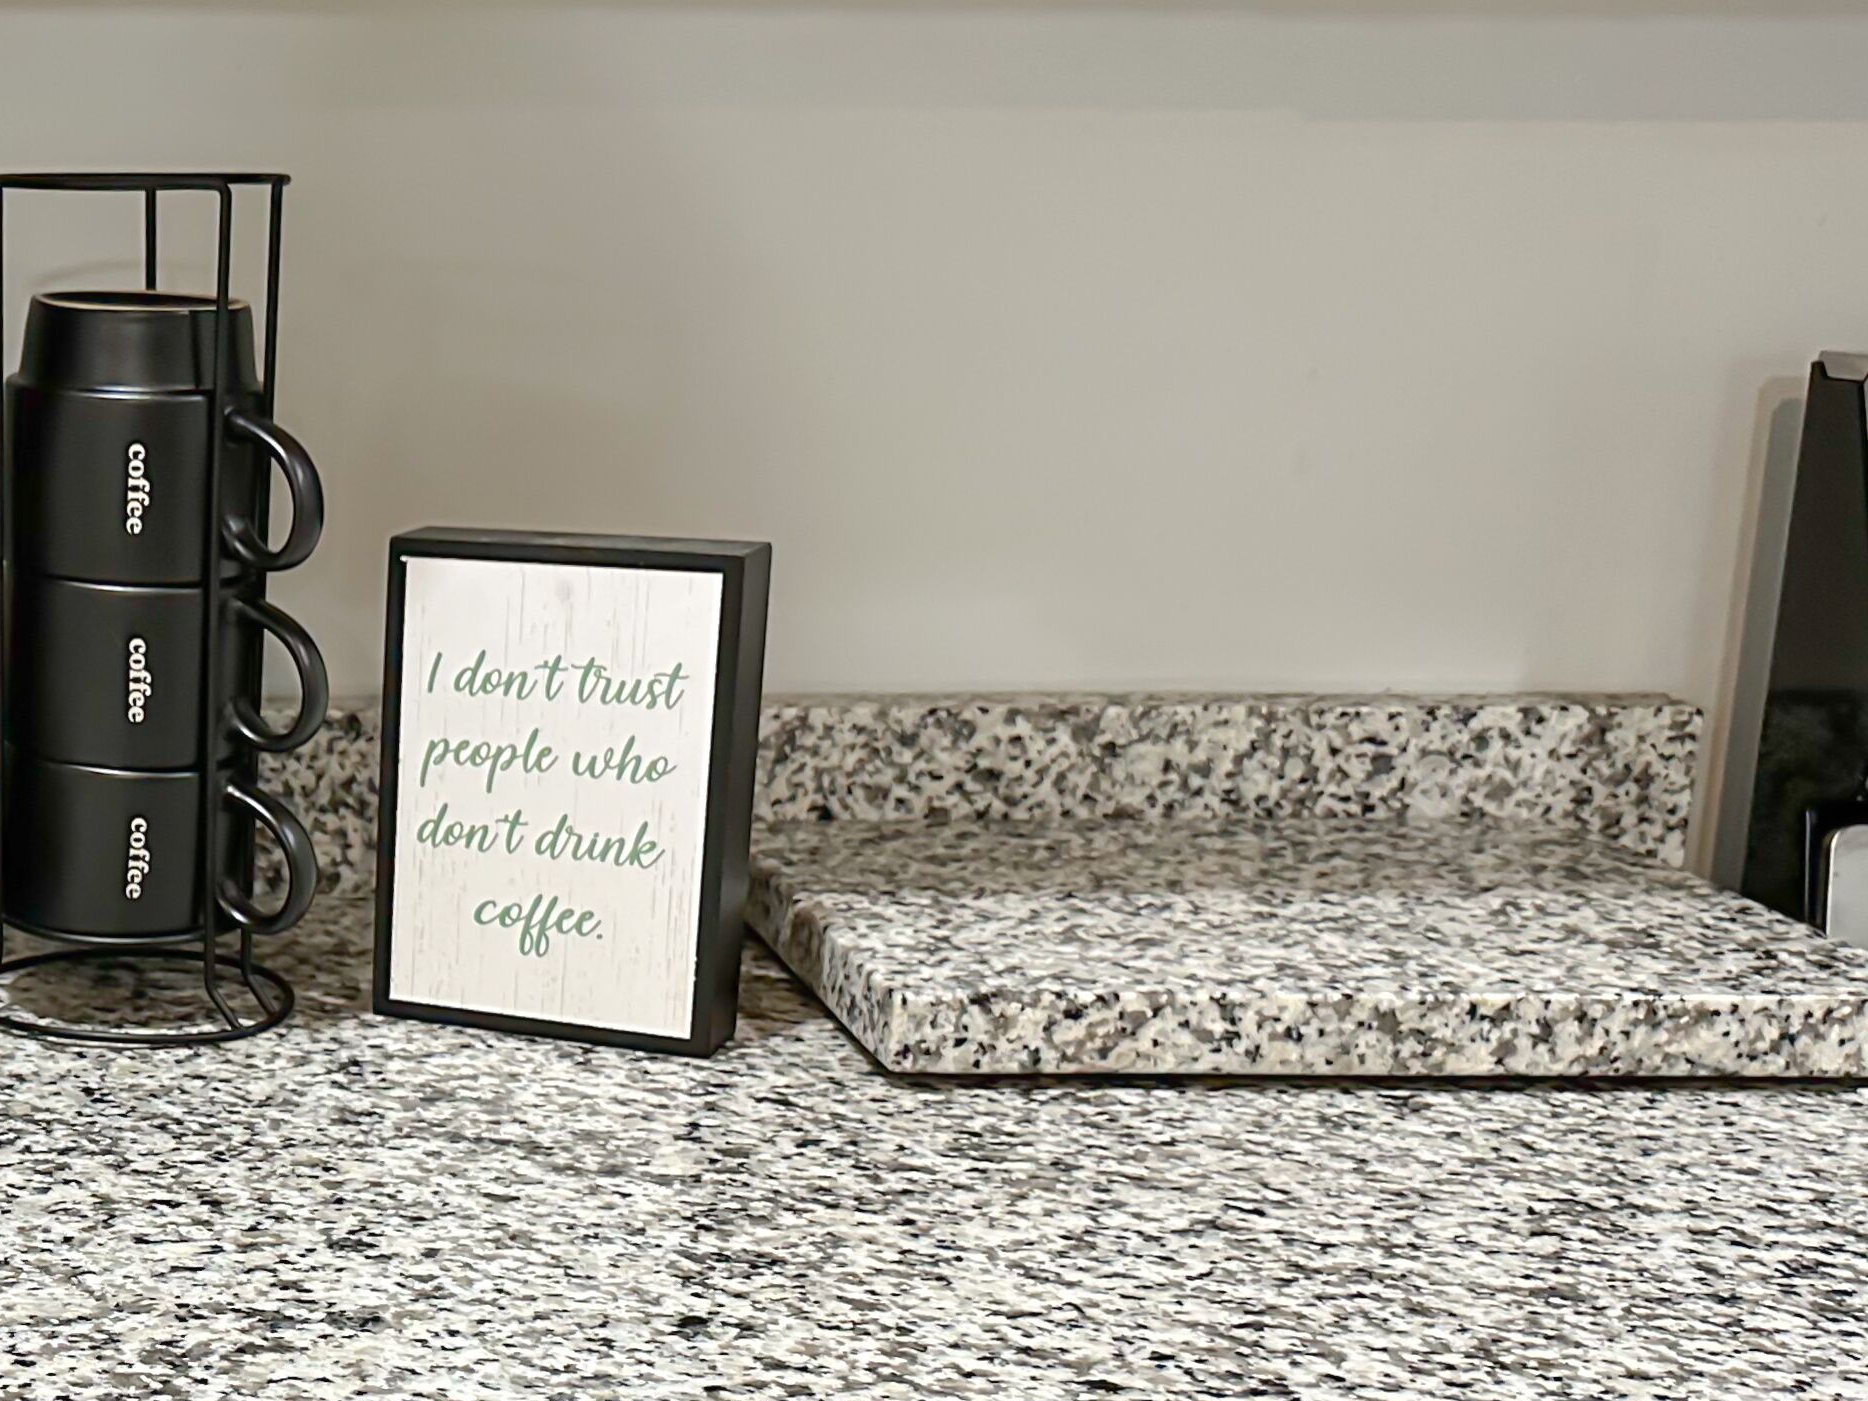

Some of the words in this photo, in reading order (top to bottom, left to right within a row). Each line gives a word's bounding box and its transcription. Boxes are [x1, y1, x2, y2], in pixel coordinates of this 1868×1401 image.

[126, 442, 150, 535] coffee
[128, 637, 151, 724] coffee
[427, 651, 443, 694] I
[453, 649, 568, 701] don't
[571, 656, 690, 710] trust
[419, 727, 558, 793] people
[571, 734, 677, 784] who
[125, 817, 150, 899] coffee
[416, 802, 529, 854] don't
[534, 813, 665, 869] drink
[473, 893, 604, 957] coffee.
